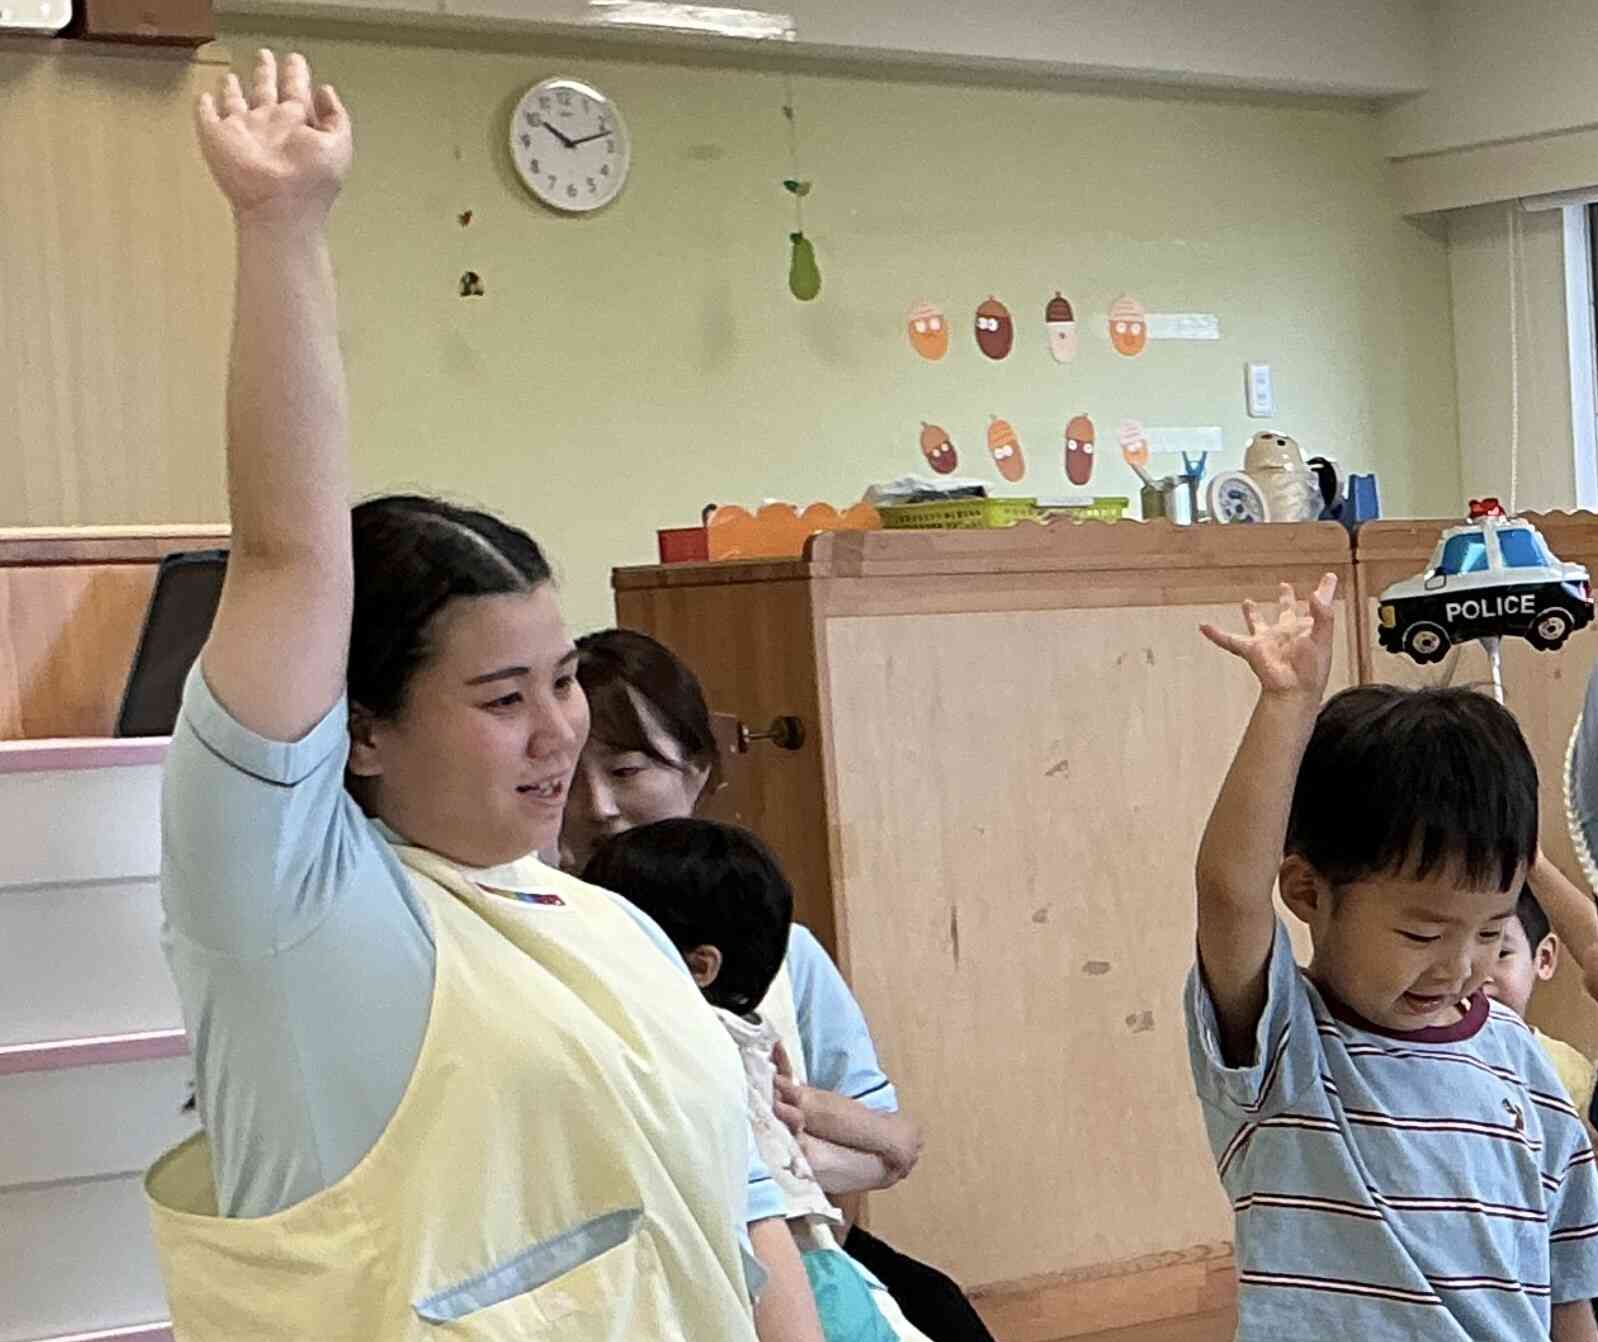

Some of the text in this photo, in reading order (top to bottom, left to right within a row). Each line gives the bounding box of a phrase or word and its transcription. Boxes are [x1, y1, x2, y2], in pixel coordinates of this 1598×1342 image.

[547, 174, 557, 190] 7
[566, 183, 577, 197] 6
[1445, 594, 1535, 622] POLICE
